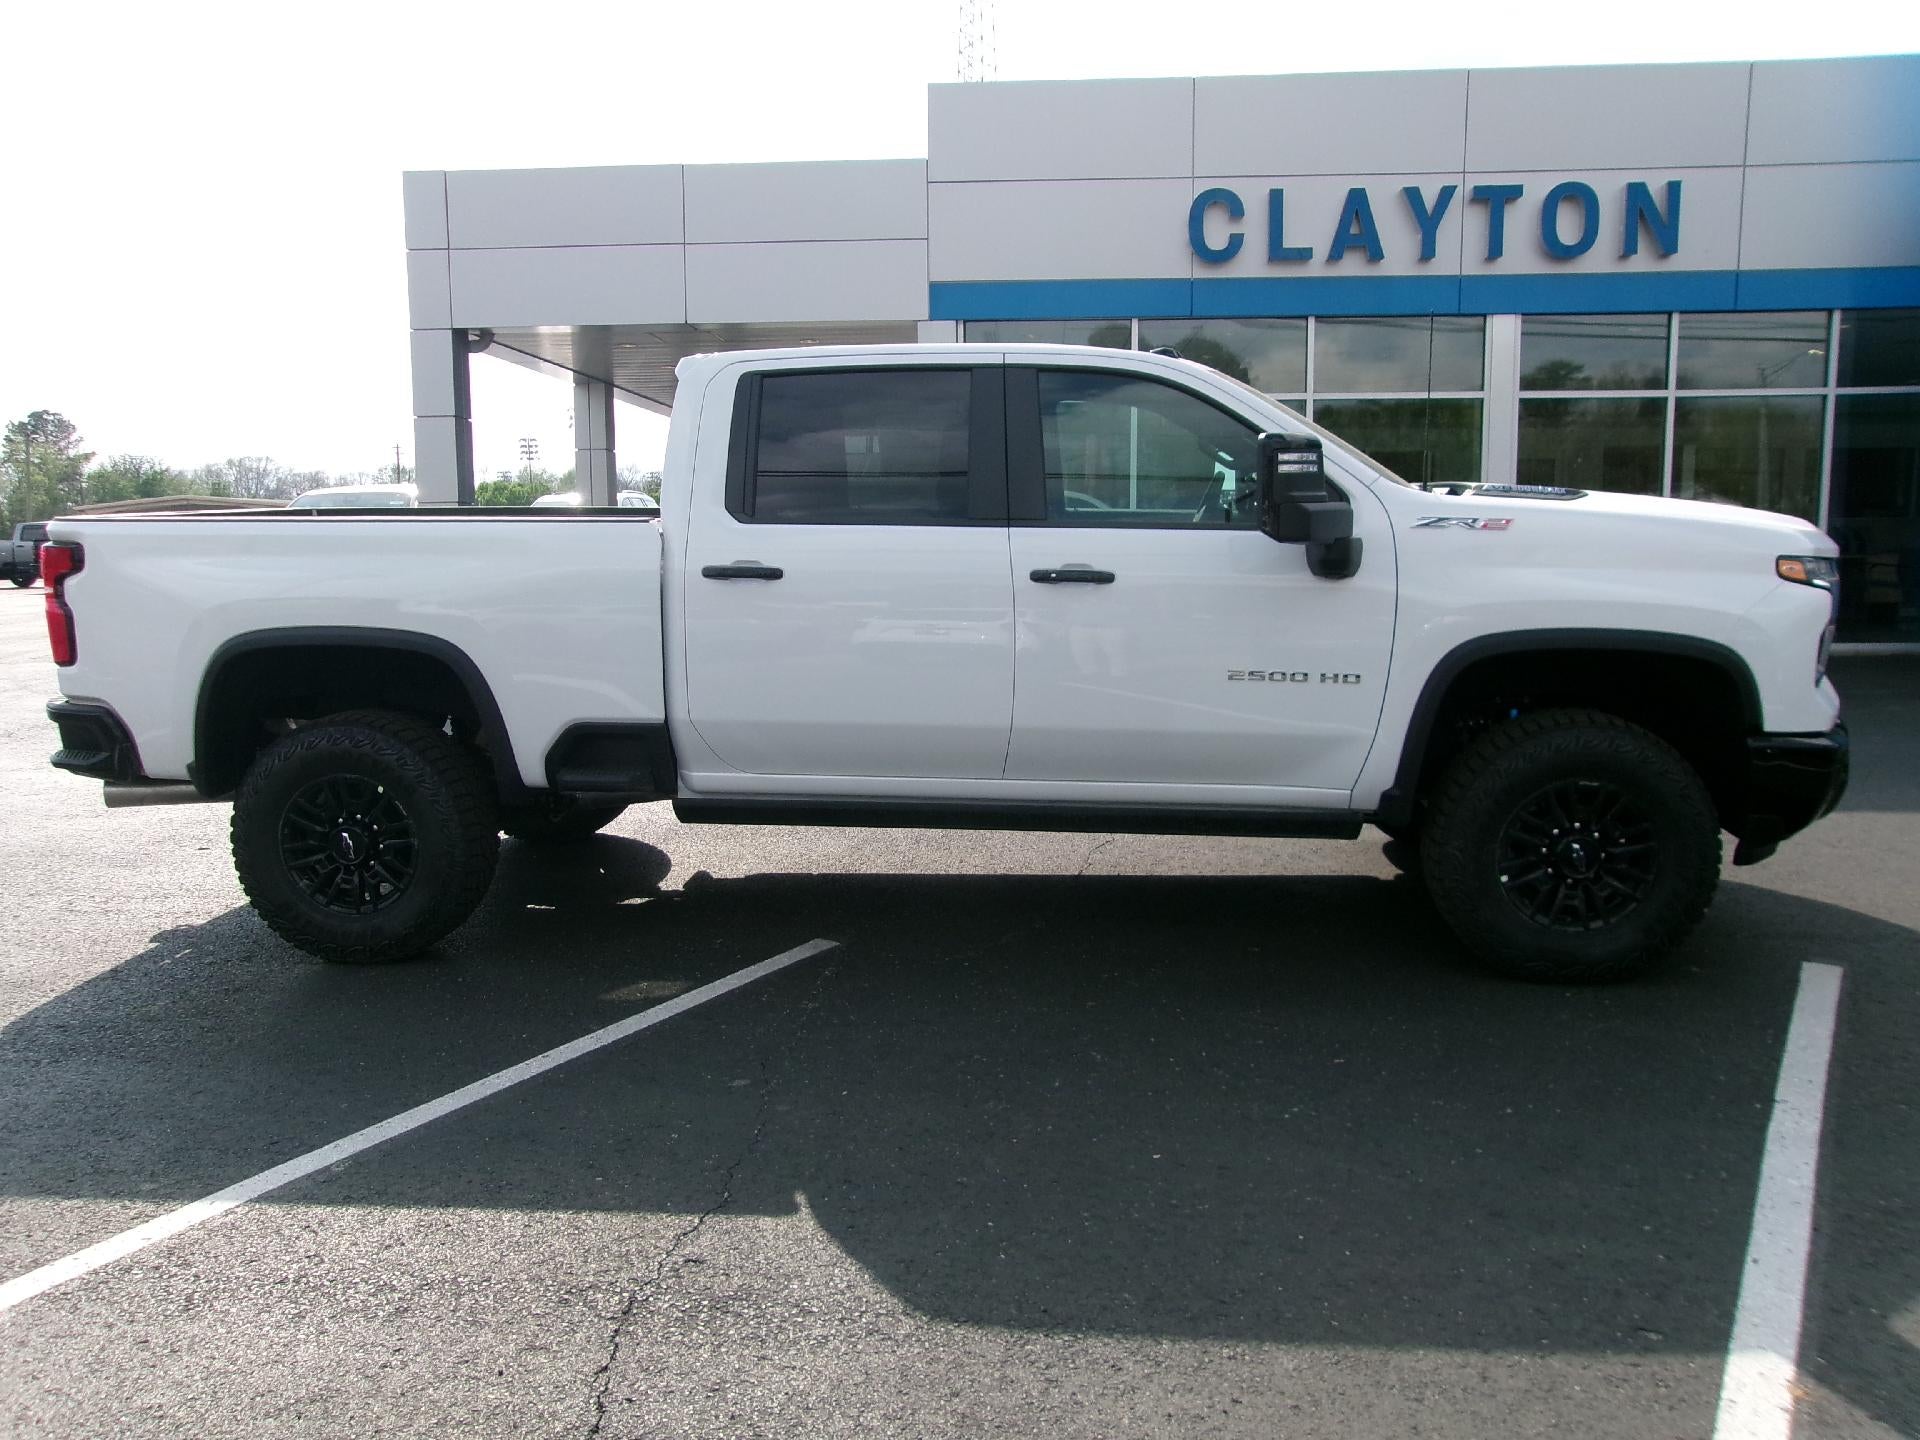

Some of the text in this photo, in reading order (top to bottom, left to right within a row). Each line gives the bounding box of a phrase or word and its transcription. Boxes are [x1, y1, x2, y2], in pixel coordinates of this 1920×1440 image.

[1188, 179, 1682, 264] CLAYTON
[1409, 516, 1515, 530] ZR2
[1227, 670, 1361, 684] 2500 HD
